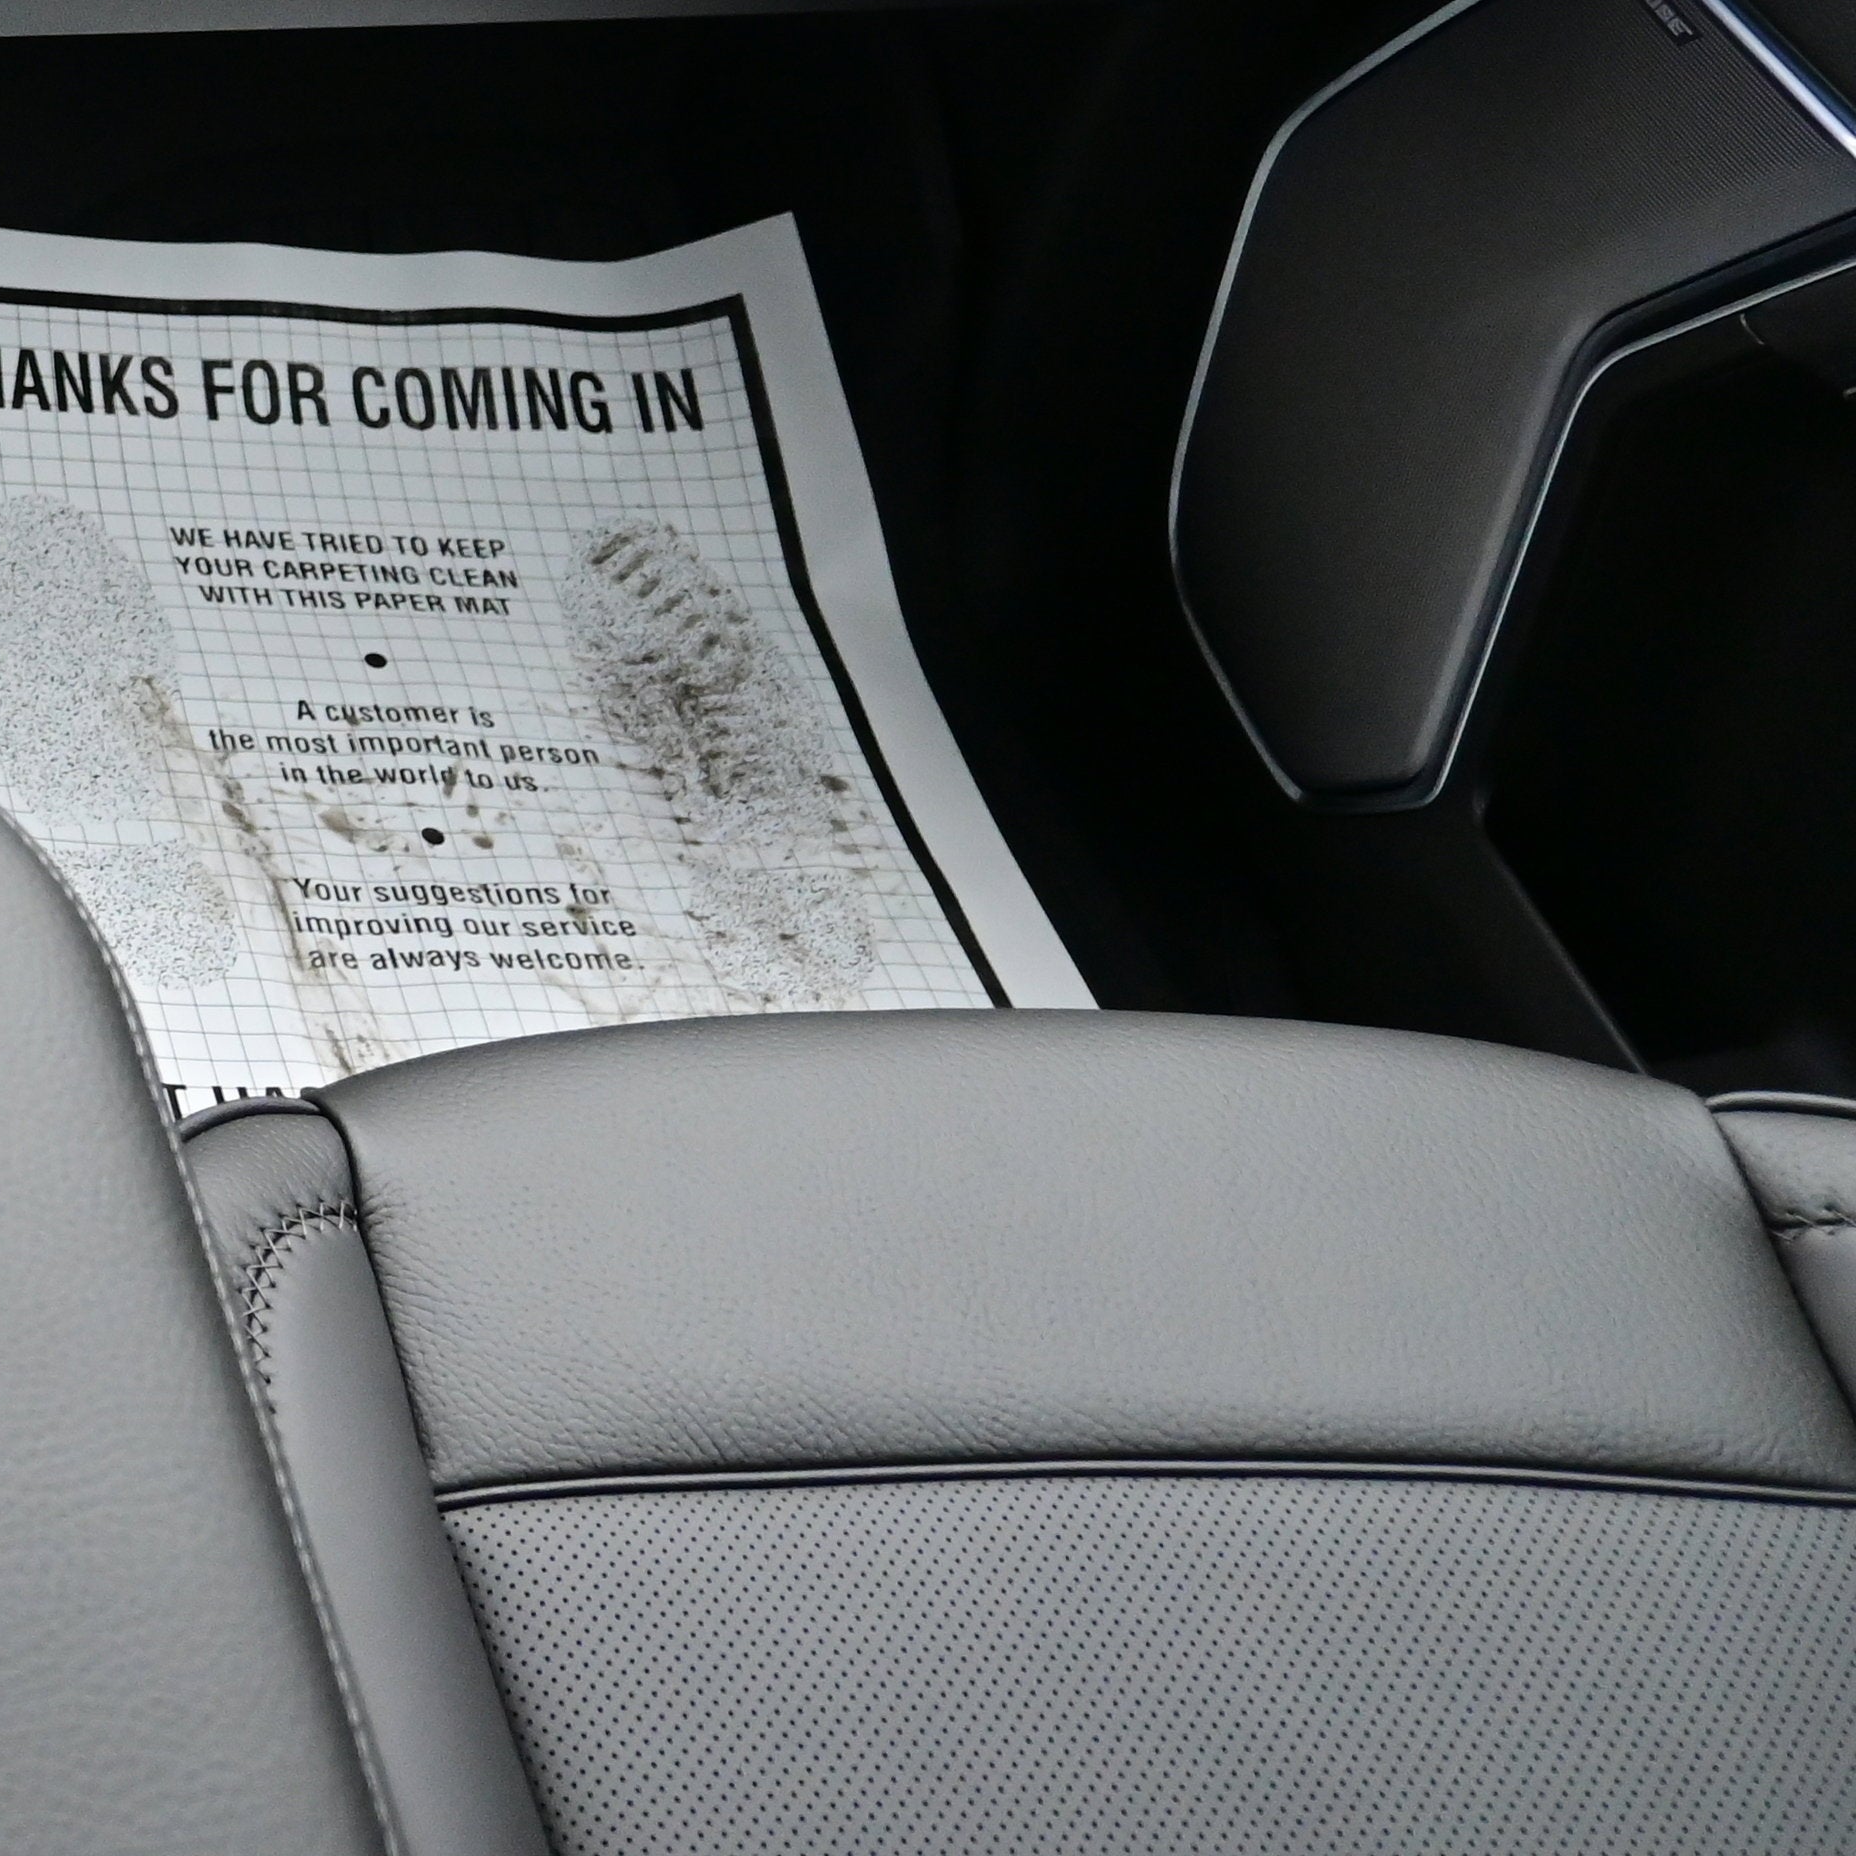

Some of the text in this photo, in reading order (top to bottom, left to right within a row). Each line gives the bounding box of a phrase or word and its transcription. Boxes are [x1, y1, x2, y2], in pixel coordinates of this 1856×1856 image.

[202, 358, 330, 427] FOR
[352, 366, 613, 434] COMING
[631, 367, 703, 434] IN
[169, 526, 506, 560] WE HAVE TRIED TO KEEP
[173, 556, 520, 589] YOUR CARPETING CLEAN
[198, 585, 511, 616] WITH THIS PAPER MAT
[297, 700, 496, 729] A customer is
[208, 729, 600, 766] the most important person
[280, 762, 549, 793] in the world to us.
[293, 878, 612, 906] Your suggestions for
[293, 911, 637, 941] improving our service
[308, 948, 645, 971] are always welcome.
